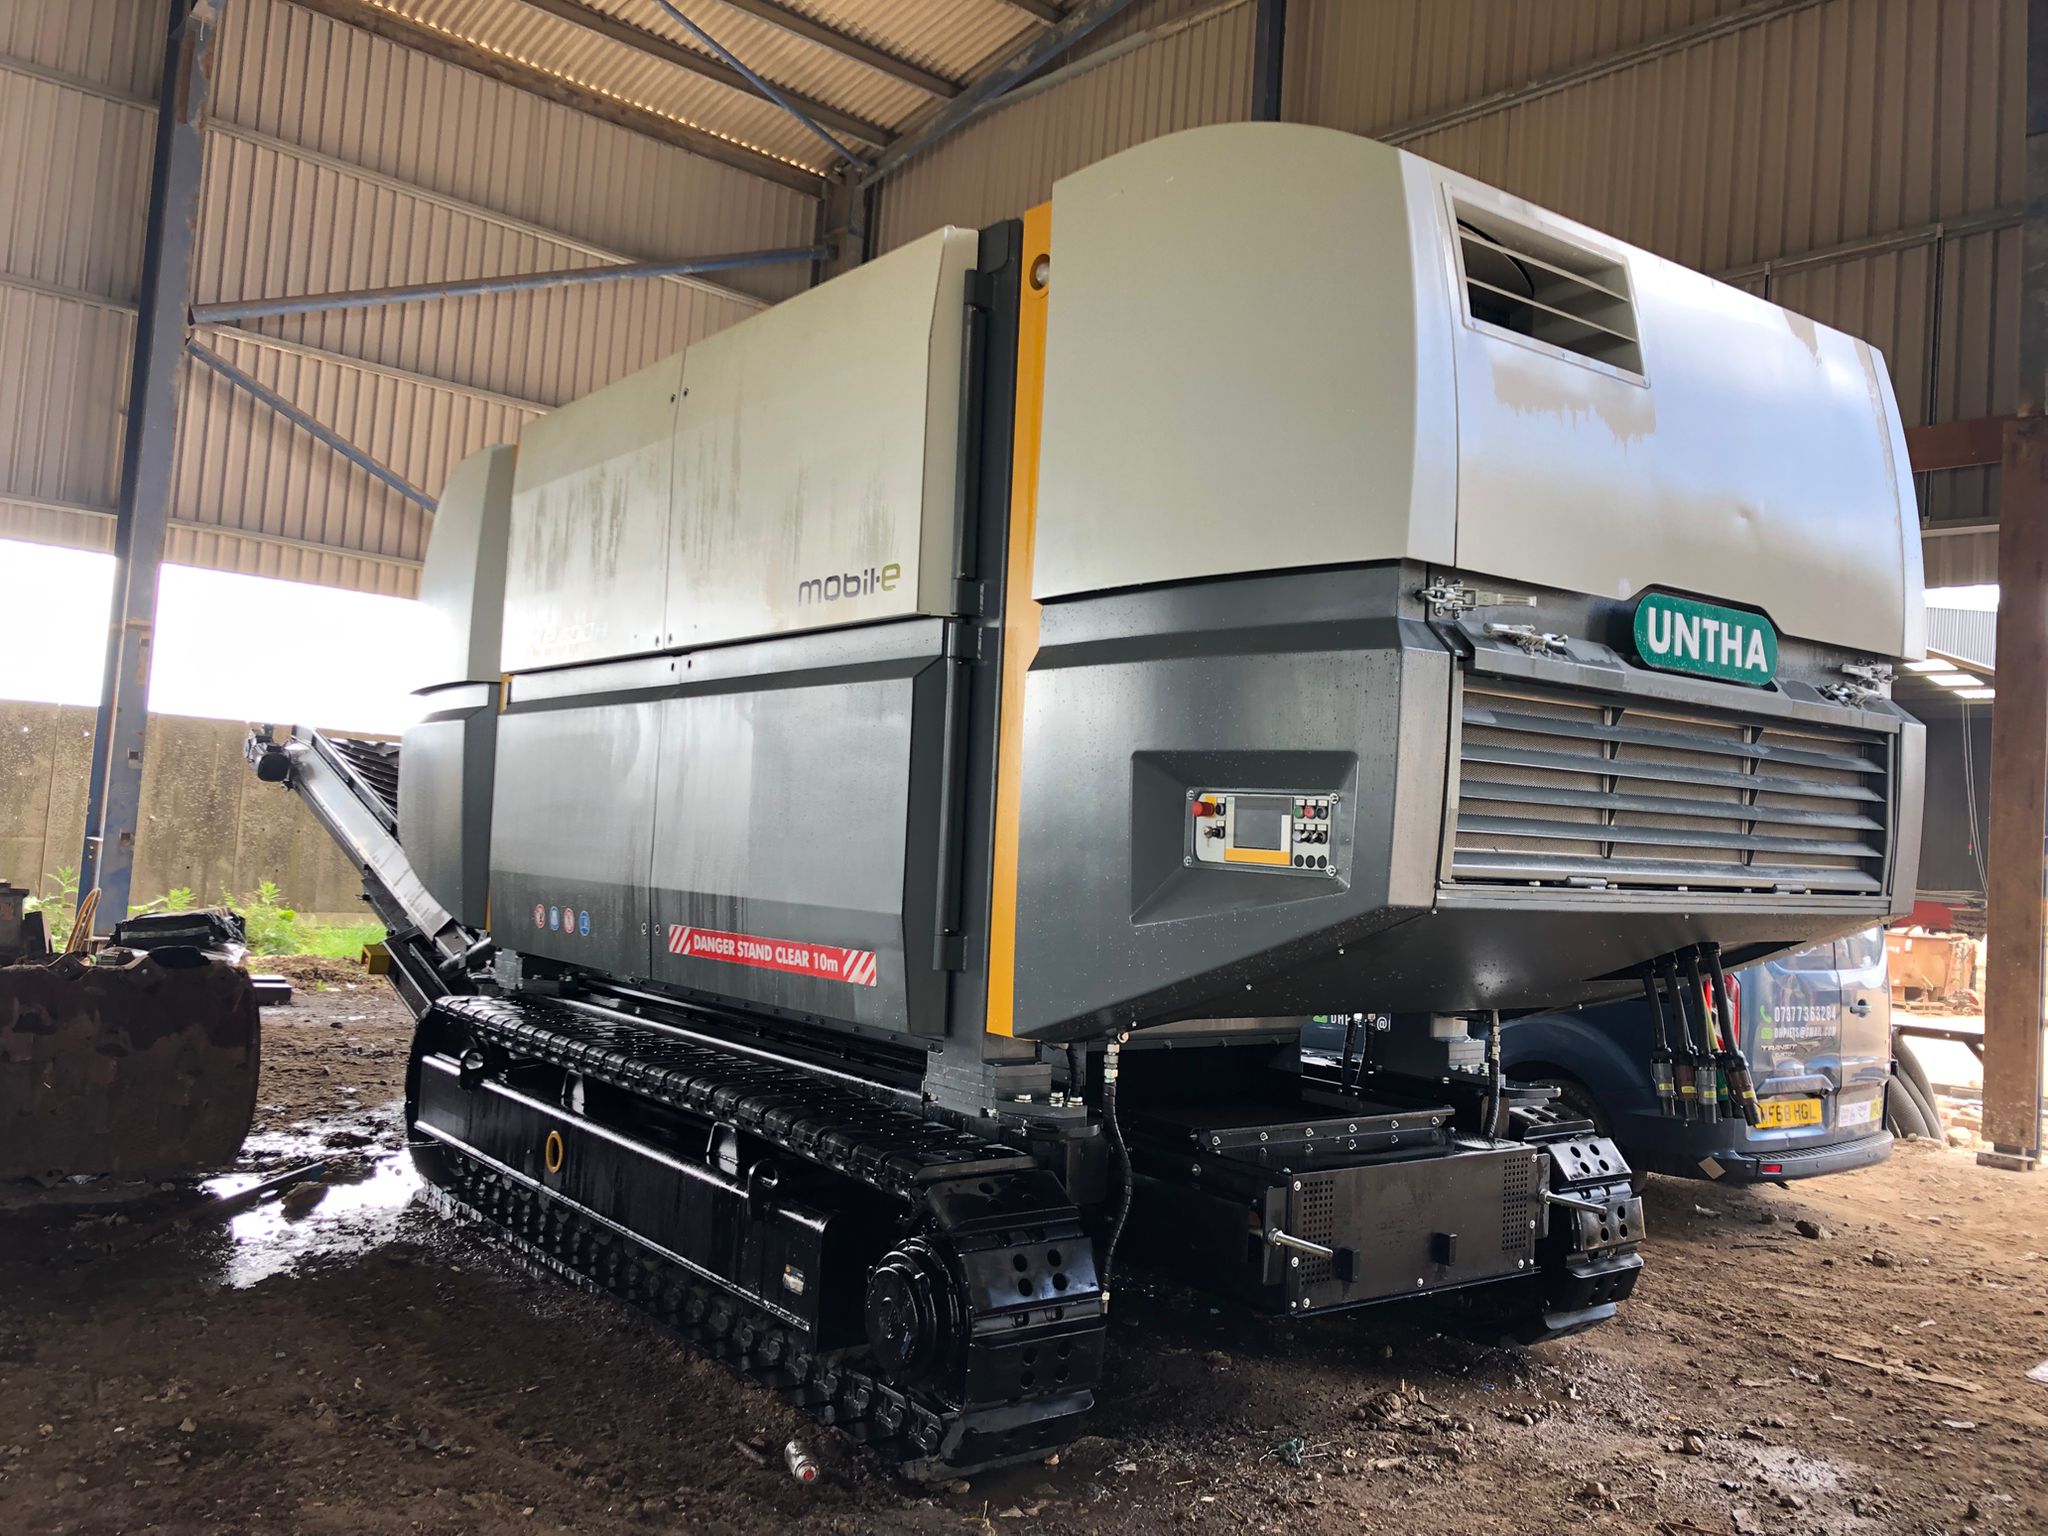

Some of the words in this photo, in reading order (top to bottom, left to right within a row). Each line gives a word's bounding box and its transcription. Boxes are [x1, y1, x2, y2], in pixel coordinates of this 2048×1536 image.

[1647, 606, 1768, 673] UNTHA
[693, 934, 735, 956] DANGER
[737, 940, 773, 962] STAND
[775, 946, 810, 968] CLEAR
[813, 952, 839, 972] 10m
